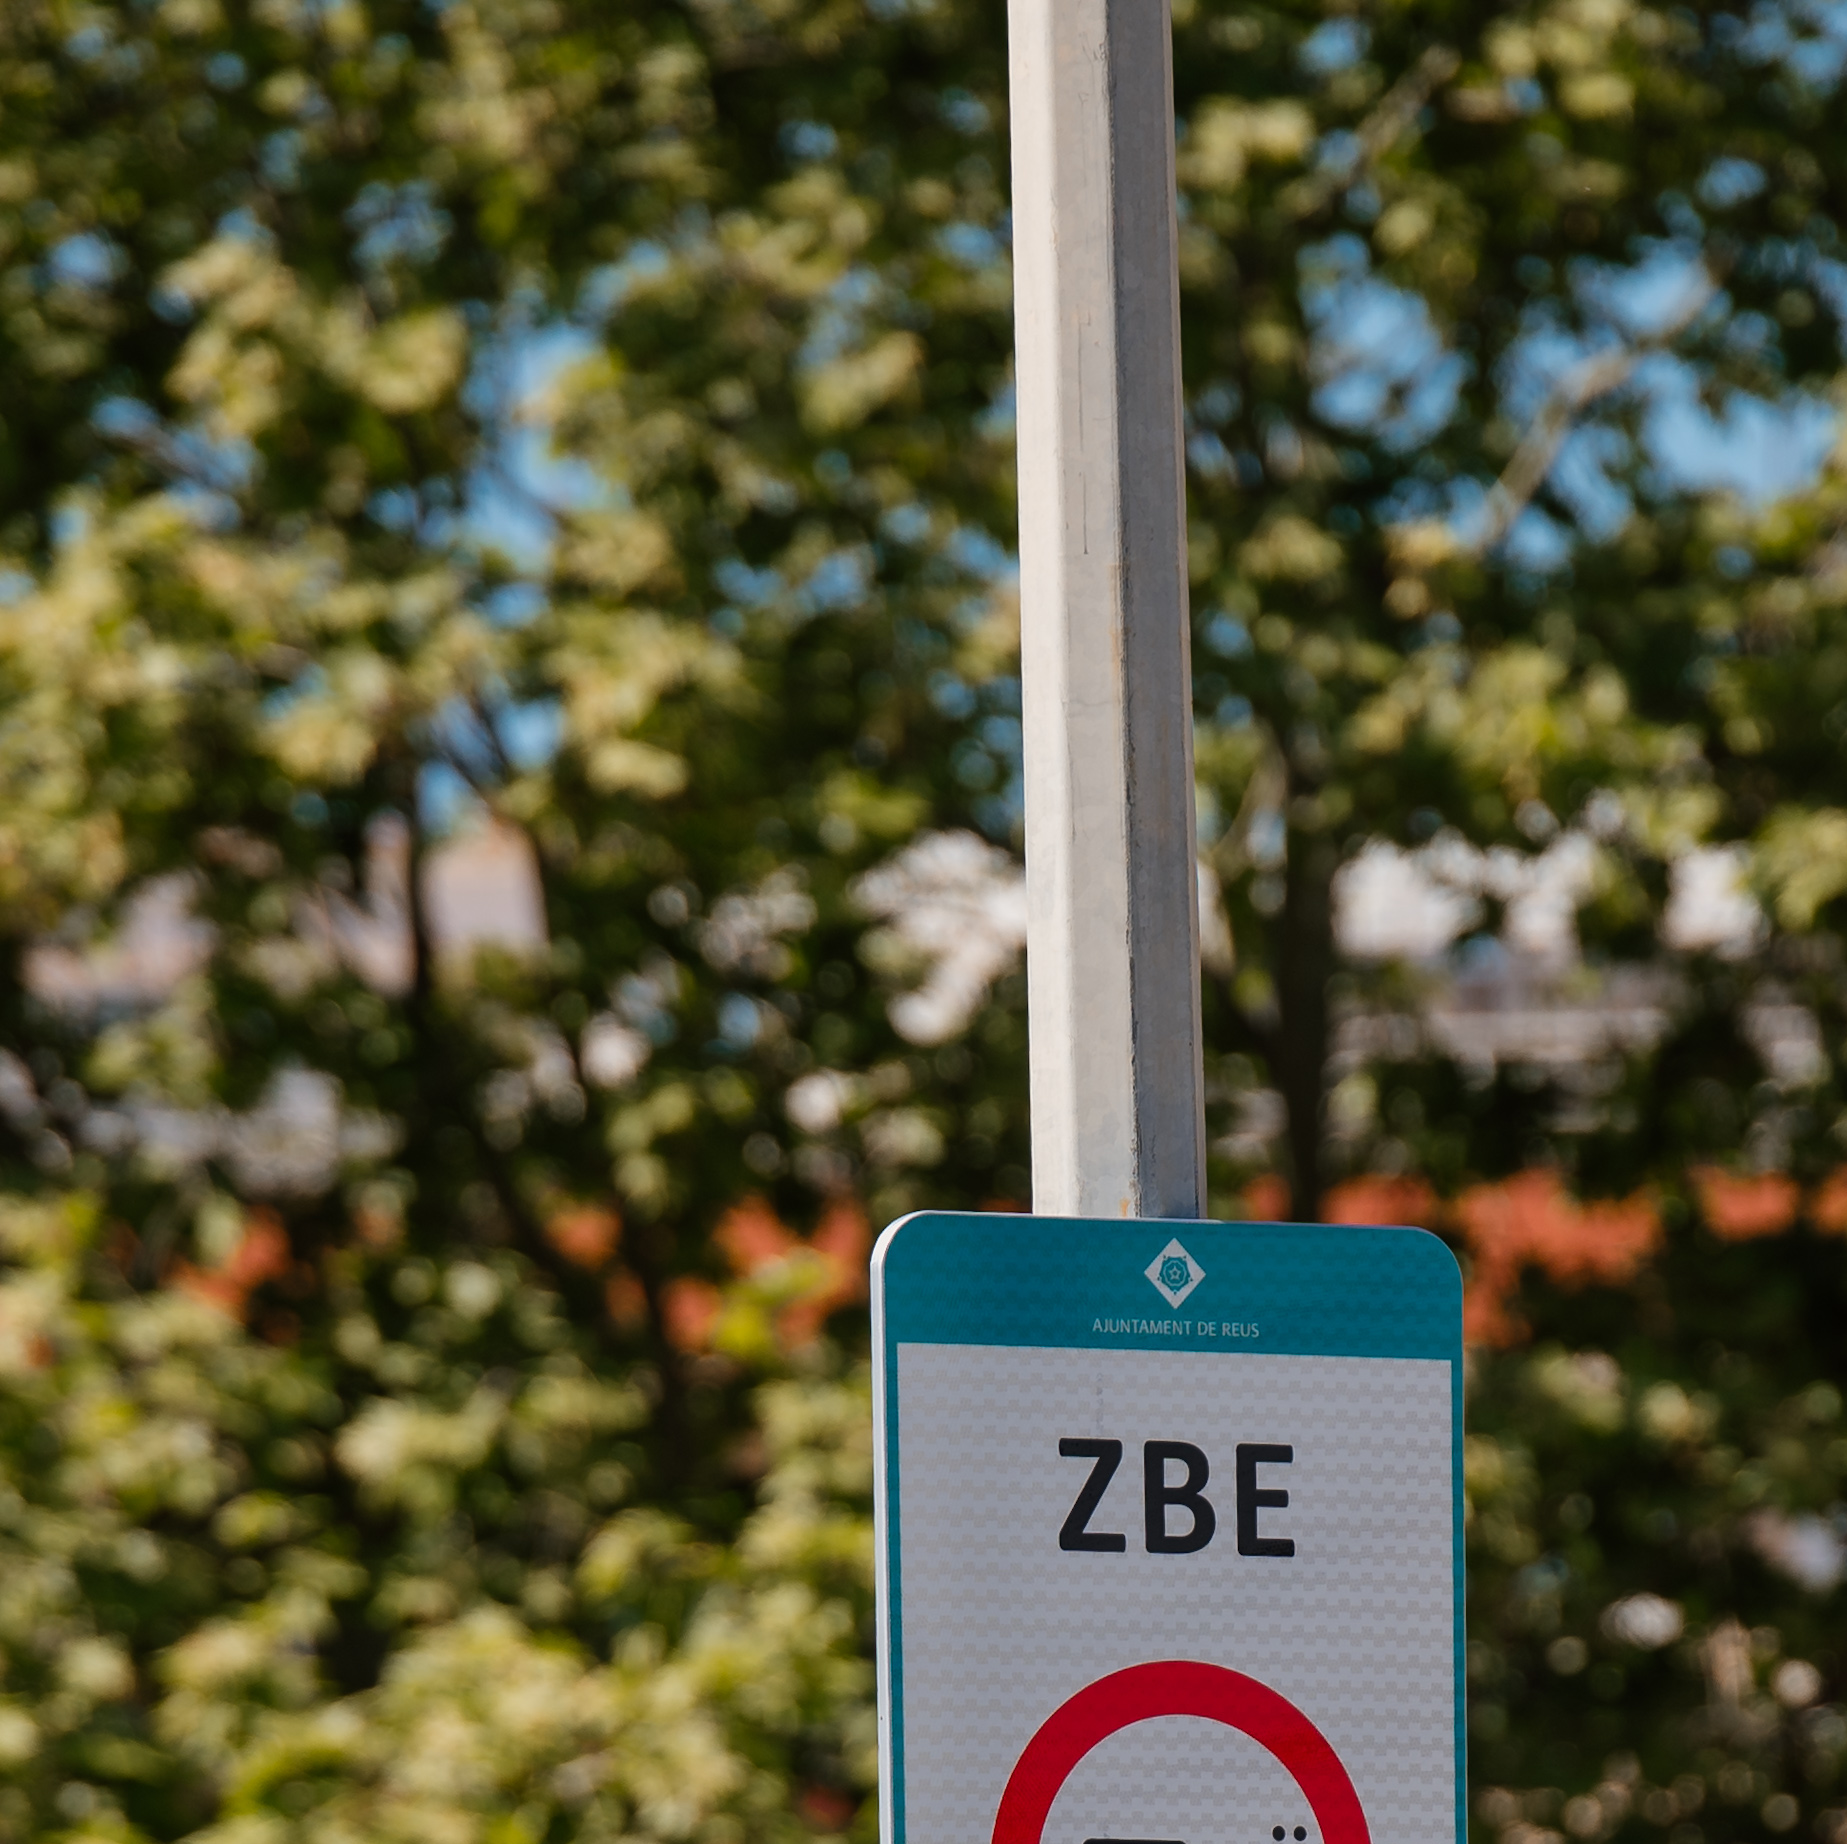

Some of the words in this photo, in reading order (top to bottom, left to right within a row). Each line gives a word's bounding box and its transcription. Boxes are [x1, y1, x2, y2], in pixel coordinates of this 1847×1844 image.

[1092, 1318, 1192, 1335] AJUNTAMENT
[1197, 1321, 1217, 1337] DE
[1222, 1322, 1260, 1338] REUS
[1058, 1437, 1296, 1557] ZBE
